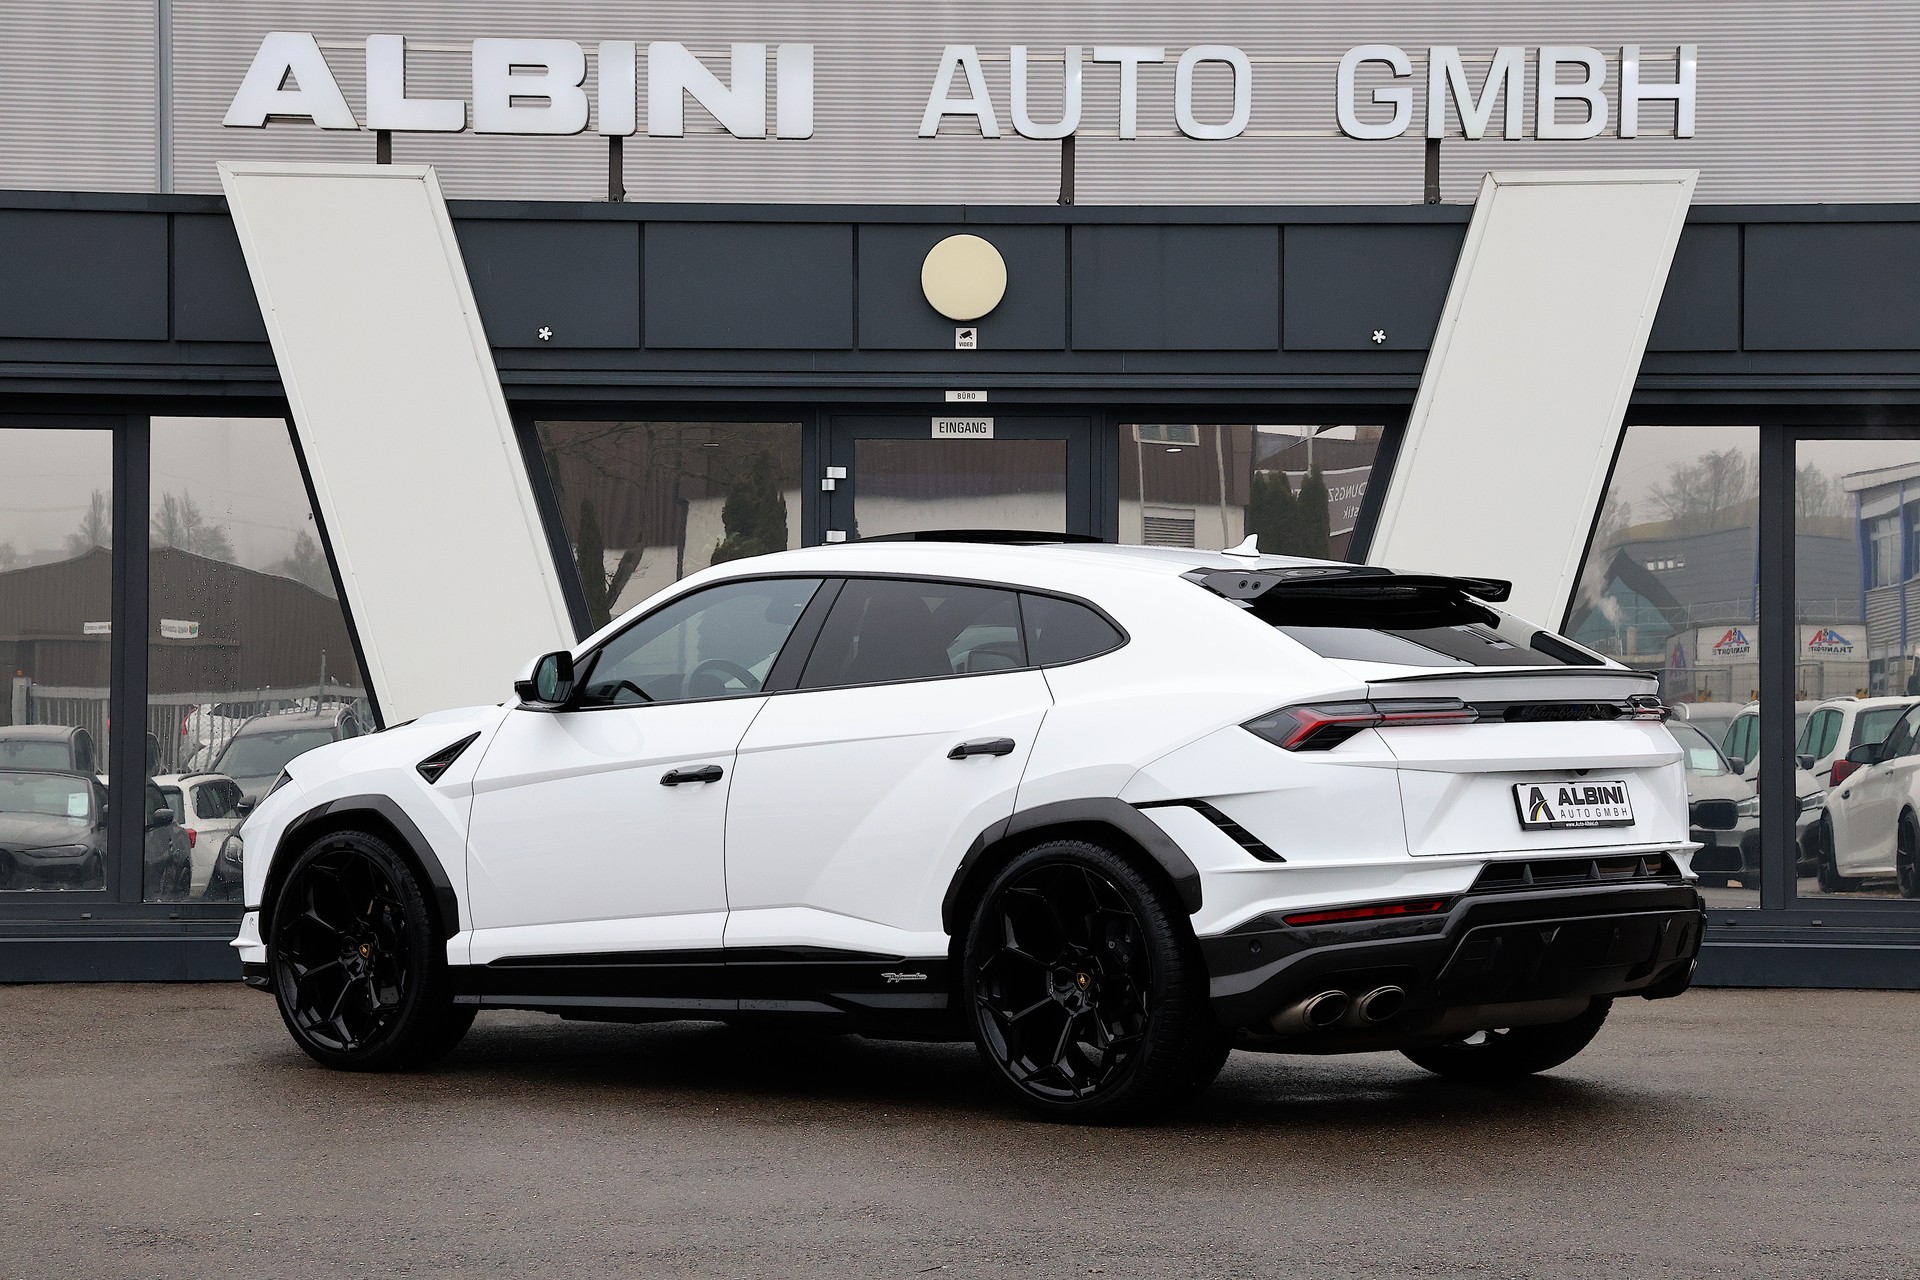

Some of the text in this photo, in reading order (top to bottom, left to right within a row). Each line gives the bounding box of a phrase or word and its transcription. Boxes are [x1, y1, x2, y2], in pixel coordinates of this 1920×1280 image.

[222, 31, 1698, 141] ALBINI AUTO GMBH
[939, 422, 987, 434] EINGANG
[1558, 786, 1625, 806] ALBINI
[1560, 807, 1628, 819] AUTO GMBH
